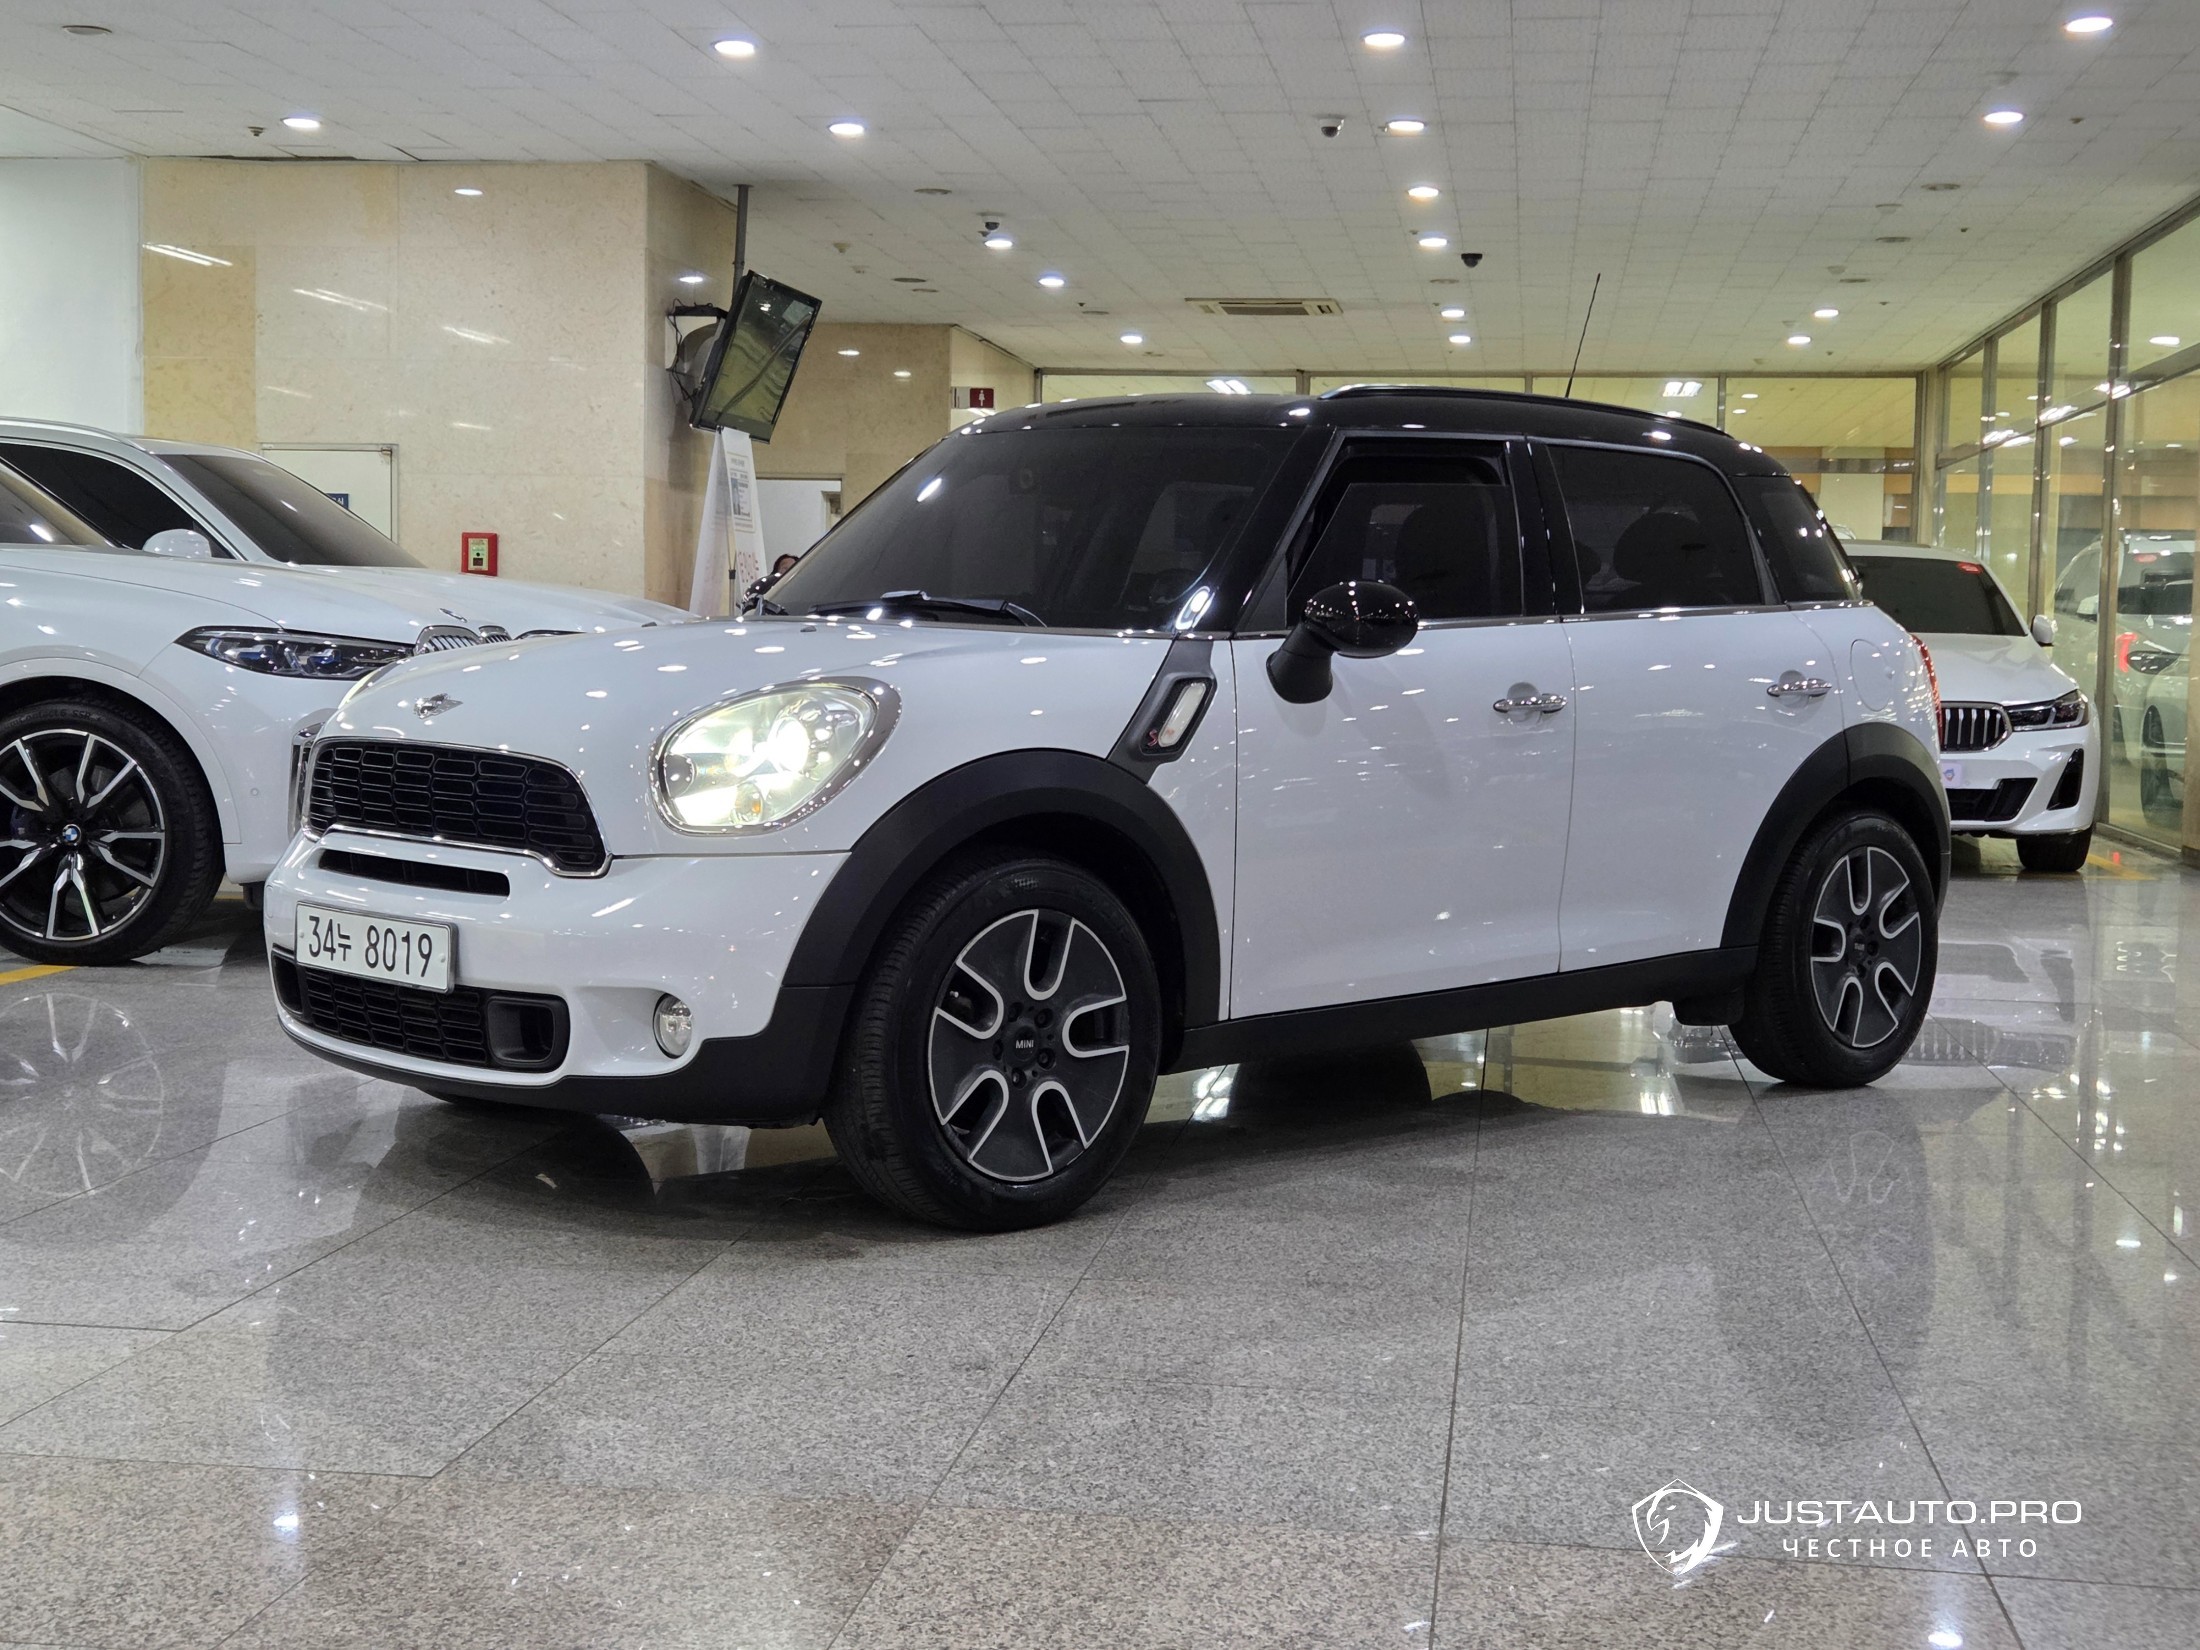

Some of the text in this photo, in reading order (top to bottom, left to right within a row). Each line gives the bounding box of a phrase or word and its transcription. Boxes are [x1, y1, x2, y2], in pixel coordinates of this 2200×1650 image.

[308, 915, 433, 978] 34누 8019
[1015, 1039, 1034, 1049] MINI
